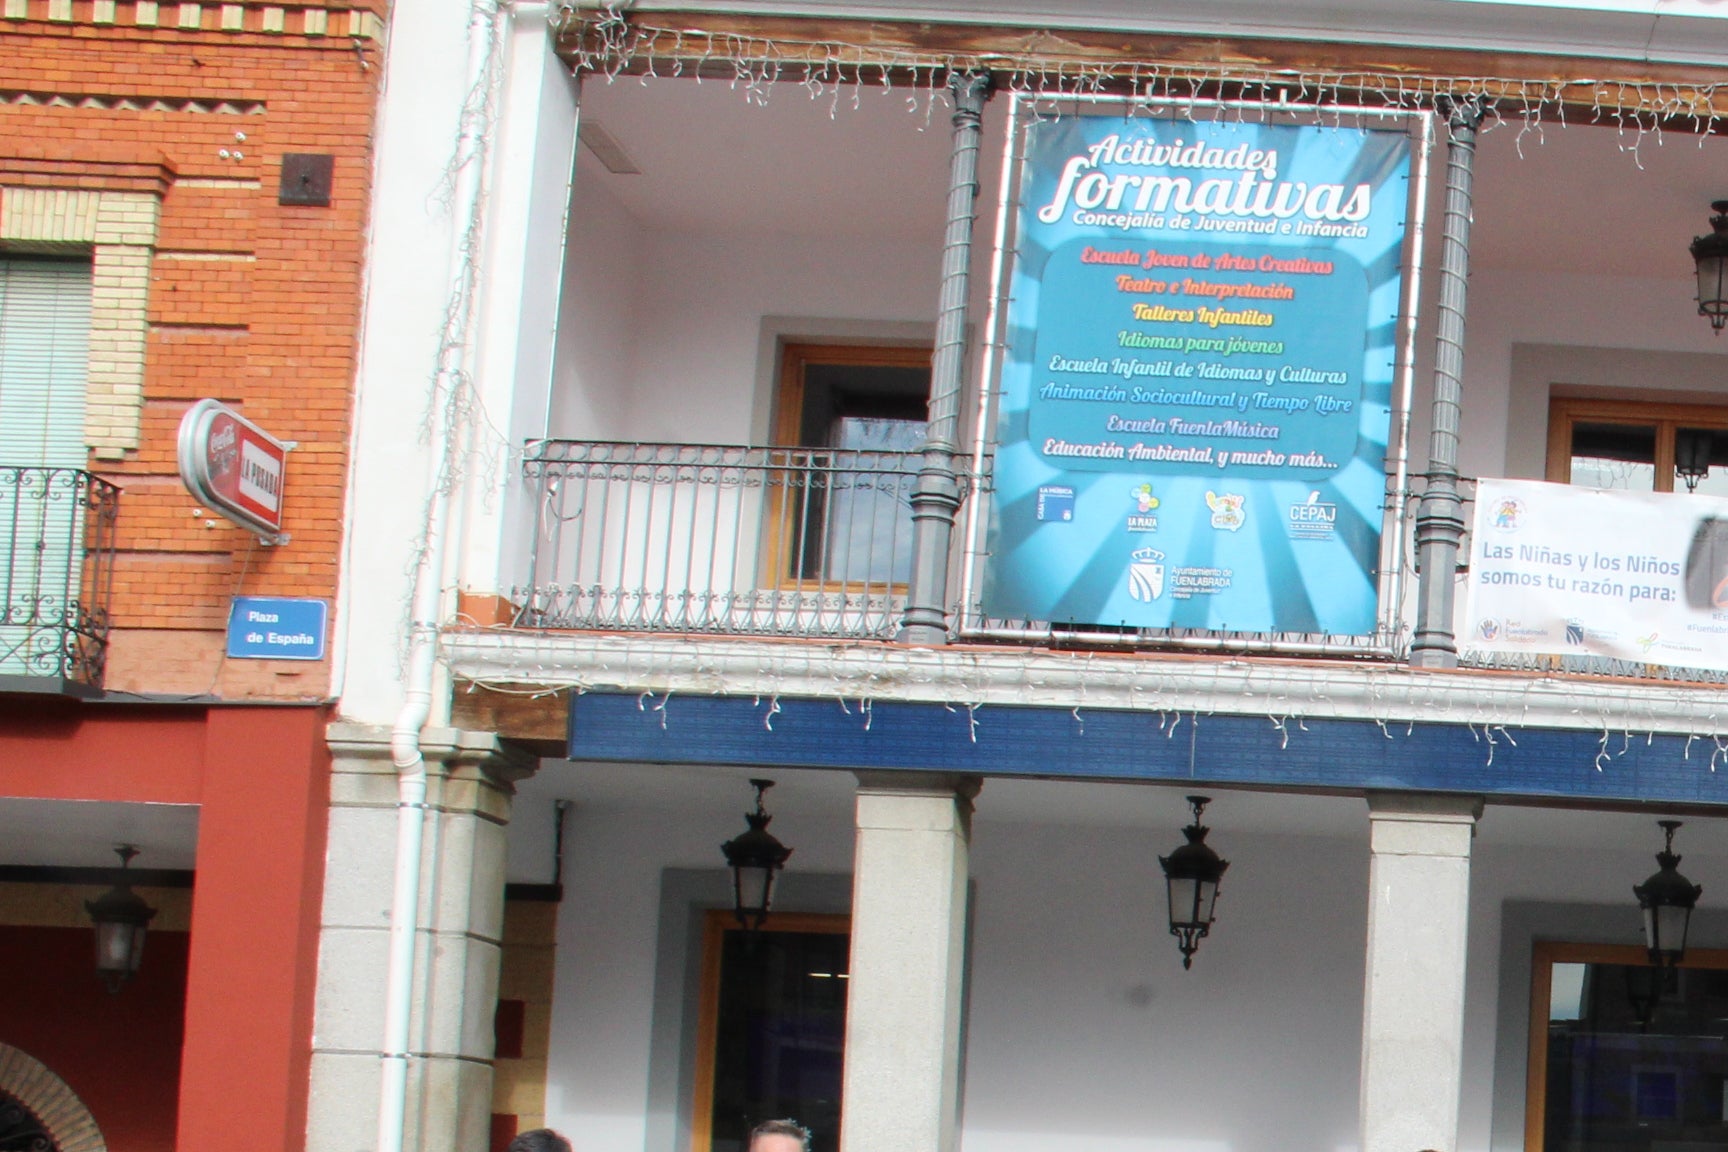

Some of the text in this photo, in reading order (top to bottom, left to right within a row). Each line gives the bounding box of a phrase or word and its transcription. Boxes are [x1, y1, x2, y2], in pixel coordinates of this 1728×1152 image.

[1089, 133, 1278, 172] Actividades
[1038, 154, 1370, 223] formativas
[1073, 209, 1368, 238] Concejalía de Juventud e Infancia
[1080, 246, 1334, 274] Escuela Joven de Artes Creativas
[1115, 274, 1294, 300] Teatro e Interpretación
[1132, 303, 1273, 328] Talleres Infantiles
[1118, 330, 1284, 355] Idiomas para jóvenes
[1049, 354, 1347, 386] Escuela Infantil de Idiomas y Culturas
[1040, 382, 1352, 414] Animación Sociocultural y Tiempo Libre
[1107, 415, 1279, 439] Escuela FuenlaMúsica
[1043, 438, 1338, 469] Educación Ambiental, y mucho más...
[251, 462, 280, 497] POSADA
[1290, 505, 1336, 522] CEPAJ
[1483, 542, 1680, 576] Las Niñas y los Niños
[1171, 576, 1231, 587] FUENLABRADA
[1481, 571, 1676, 602] somos tu razón para:
[247, 610, 279, 623] Plaza
[246, 632, 314, 646] de España
